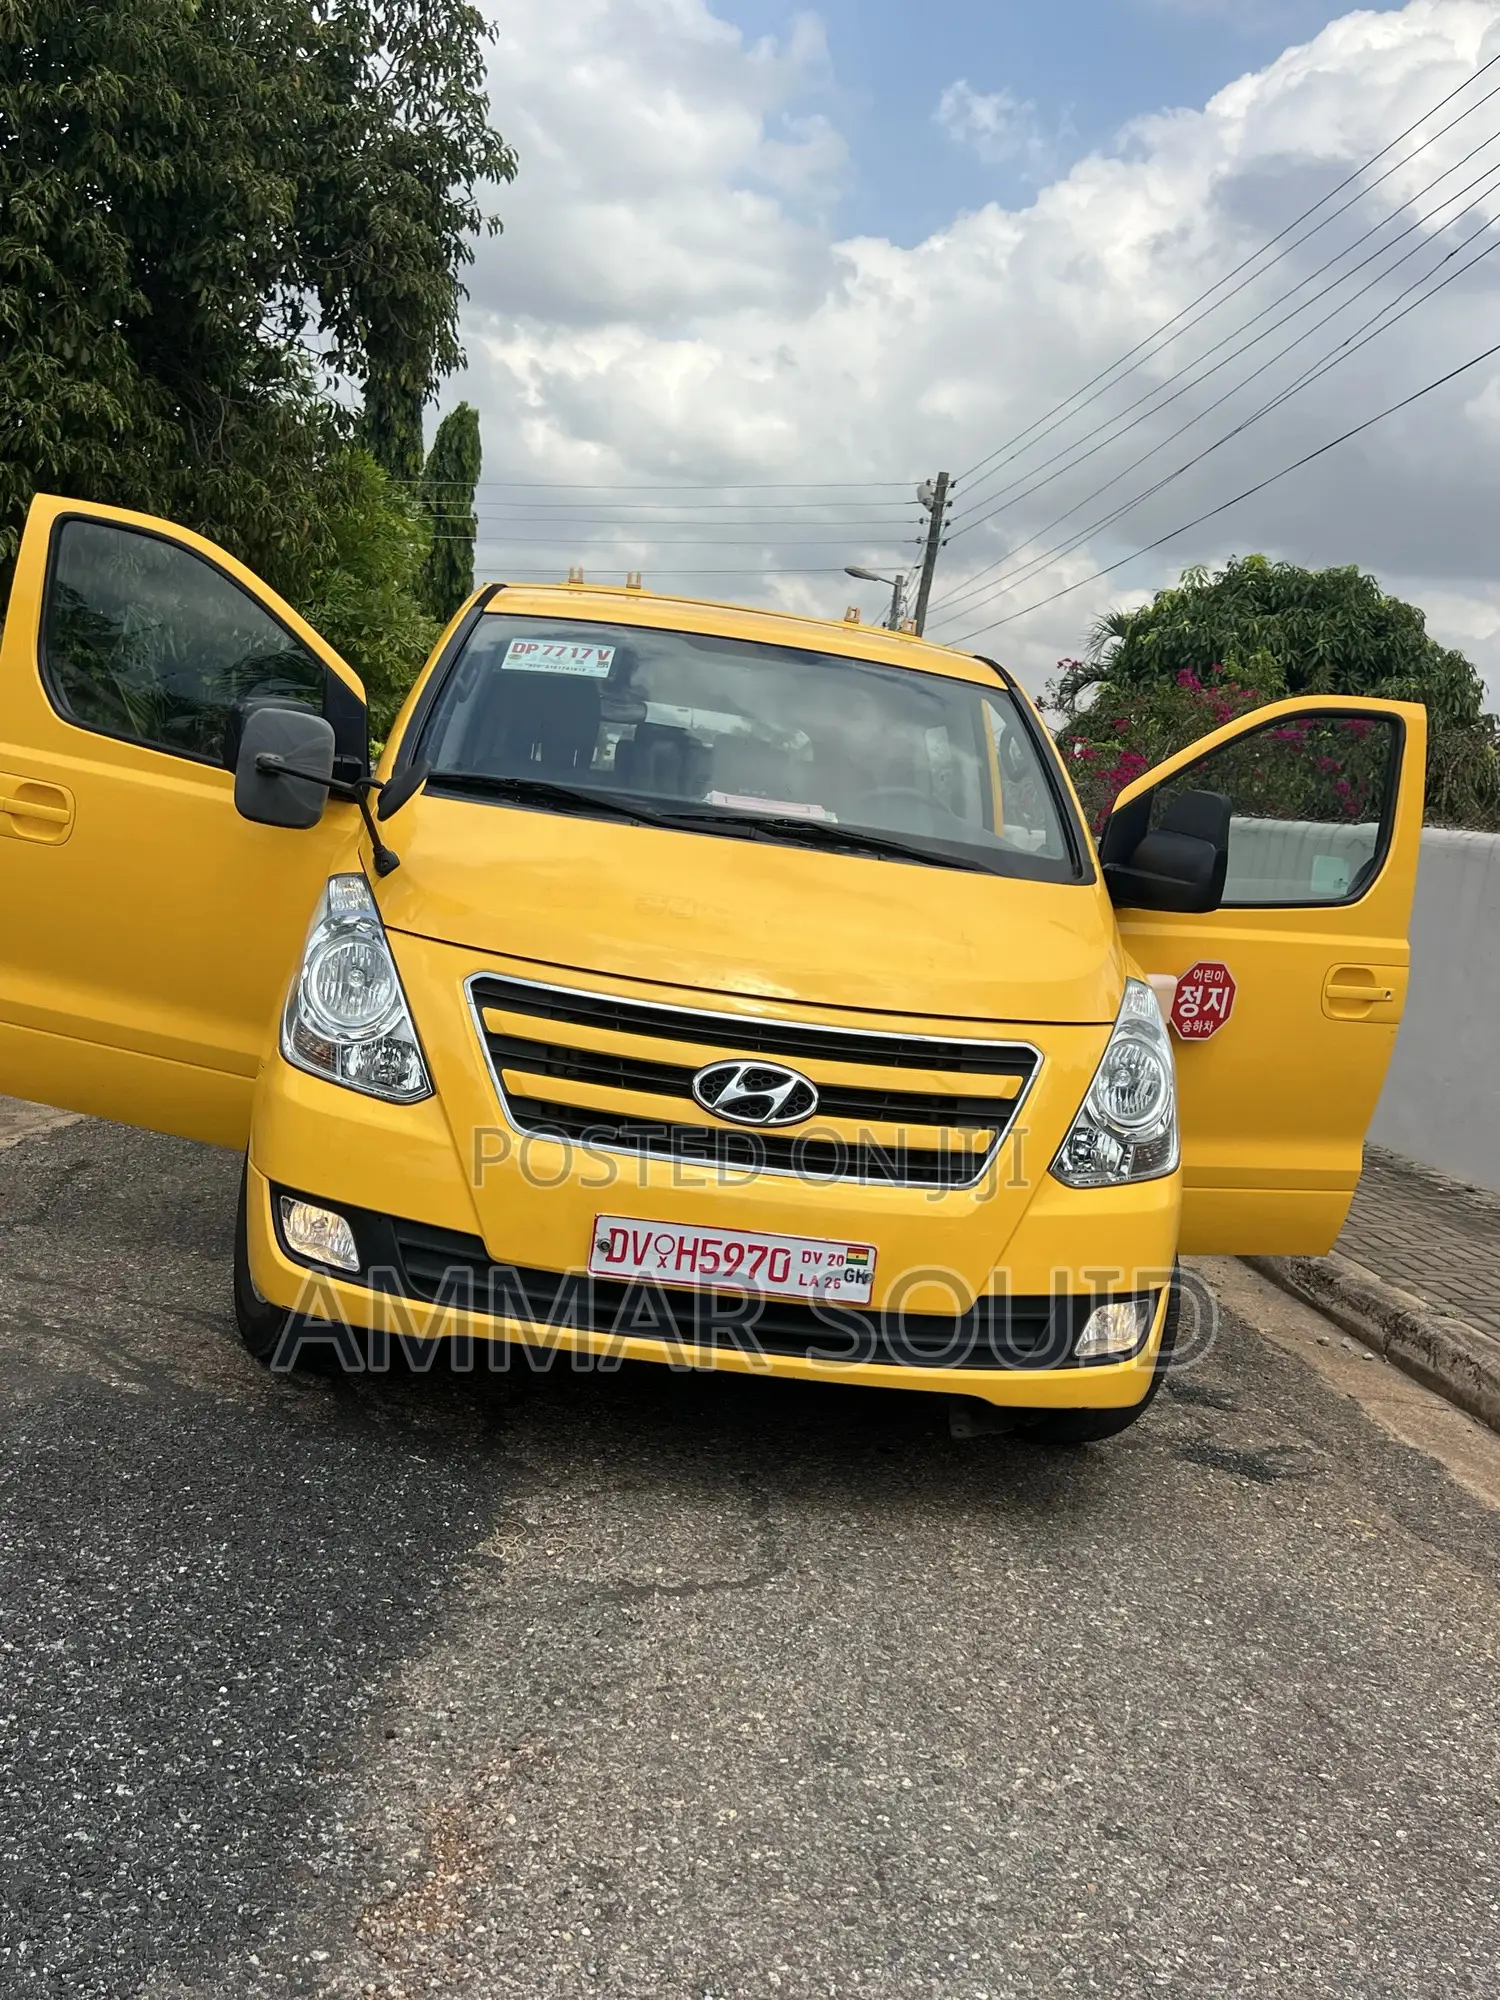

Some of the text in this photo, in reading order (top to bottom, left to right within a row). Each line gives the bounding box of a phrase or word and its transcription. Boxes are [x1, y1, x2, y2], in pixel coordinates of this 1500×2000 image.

[512, 642, 611, 661] DP 7717 V
[1193, 969, 1225, 984] 어린이
[1177, 985, 1230, 1018] 정지
[1182, 1019, 1214, 1033] 승하차
[674, 1236, 791, 1282] H5970
[801, 1250, 845, 1267] DV 20
[798, 1273, 841, 1289] LA 26
